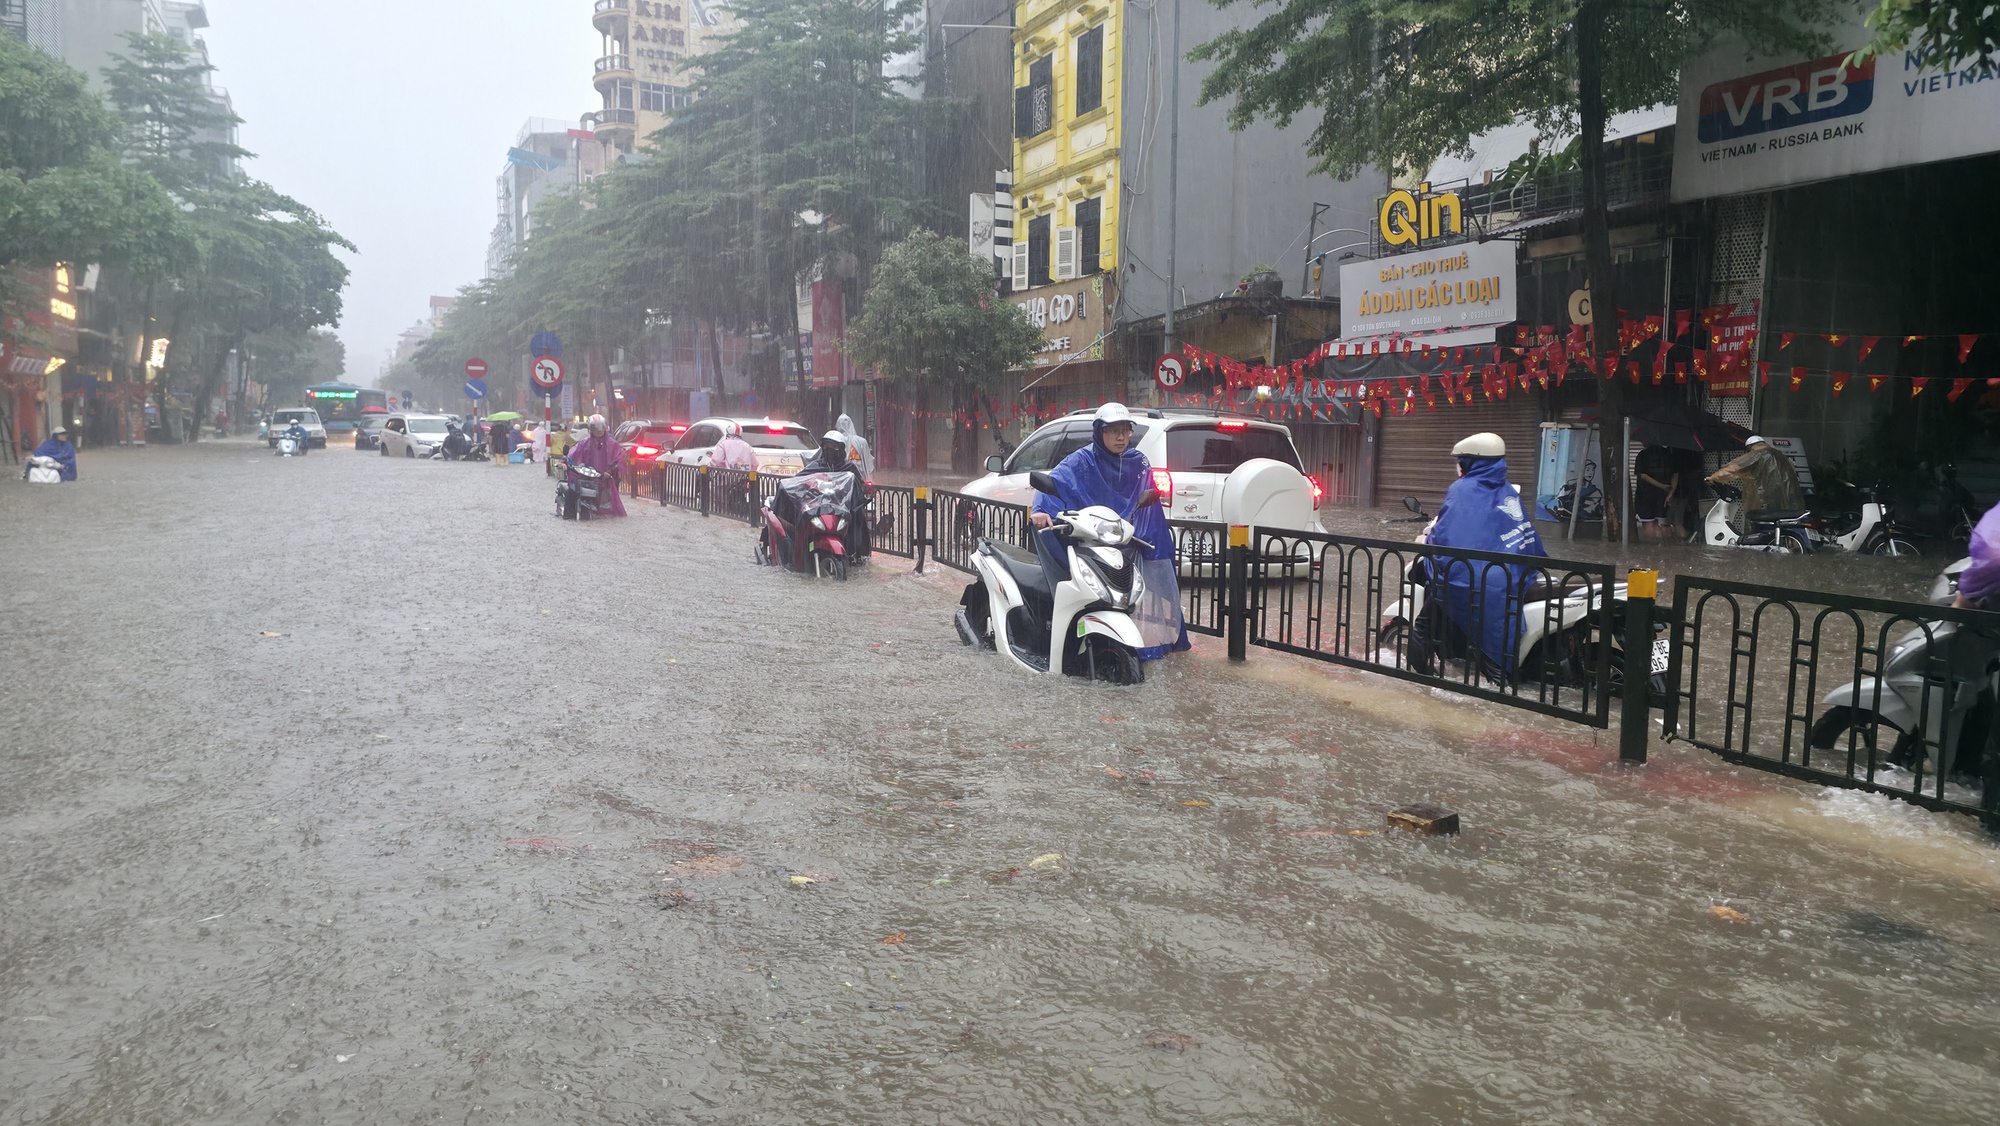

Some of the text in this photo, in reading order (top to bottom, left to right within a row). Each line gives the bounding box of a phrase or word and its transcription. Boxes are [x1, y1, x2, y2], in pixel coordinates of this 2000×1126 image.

[635, 0, 681, 22] KIM
[632, 24, 685, 46] ANH
[1721, 67, 1849, 127] VRB
[1701, 143, 1757, 163] VIETNAM
[1769, 131, 1819, 151] RUSSIA
[1822, 122, 1864, 141] BANK
[1380, 182, 1462, 246] Qin
[1436, 251, 1469, 273] THUÊ
[1049, 294, 1075, 325] GO
[1382, 285, 1412, 312] DÀI
[1414, 280, 1452, 309] CÁC
[1455, 276, 1500, 306] LOẠI
[1578, 298, 1590, 316] C
